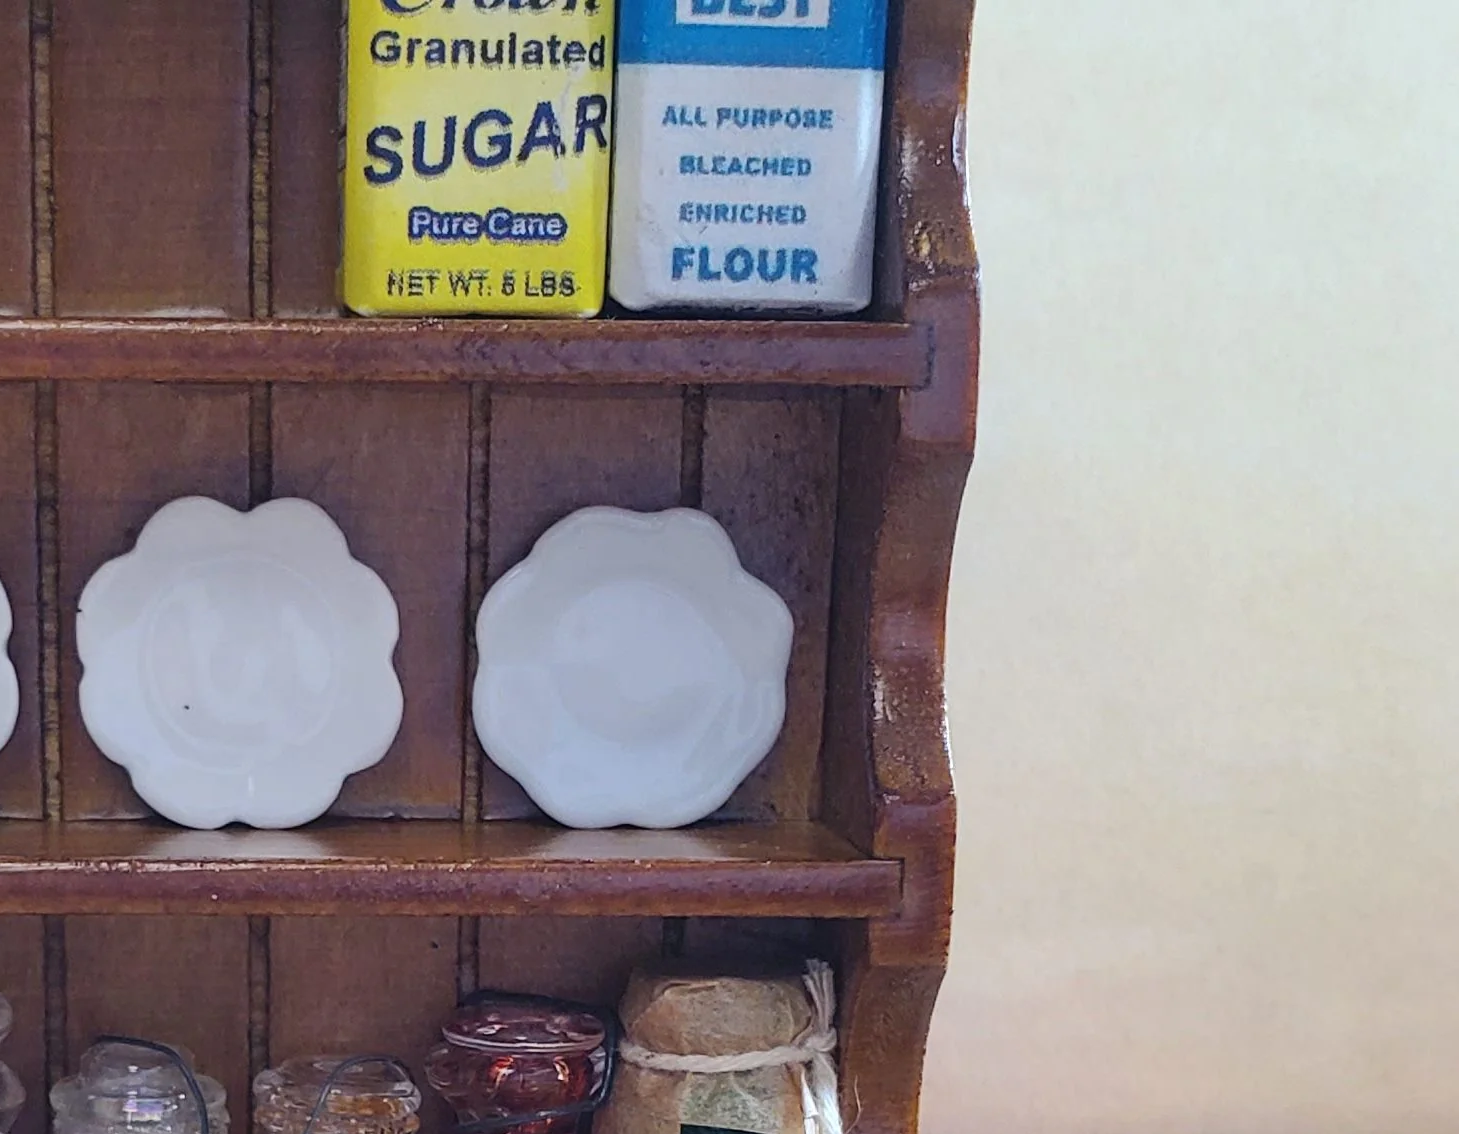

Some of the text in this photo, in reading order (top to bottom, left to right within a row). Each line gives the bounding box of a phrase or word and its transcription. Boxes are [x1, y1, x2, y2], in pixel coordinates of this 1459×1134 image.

[370, 31, 606, 67] Granulated
[662, 106, 834, 129] ALL PURPOSE
[363, 95, 607, 185] SUGAR
[679, 155, 811, 176] BLEACHED
[408, 206, 567, 242] Pure Cane
[679, 203, 807, 224] ENRICHED
[671, 247, 818, 283] FLOUR
[387, 269, 439, 297] NET
